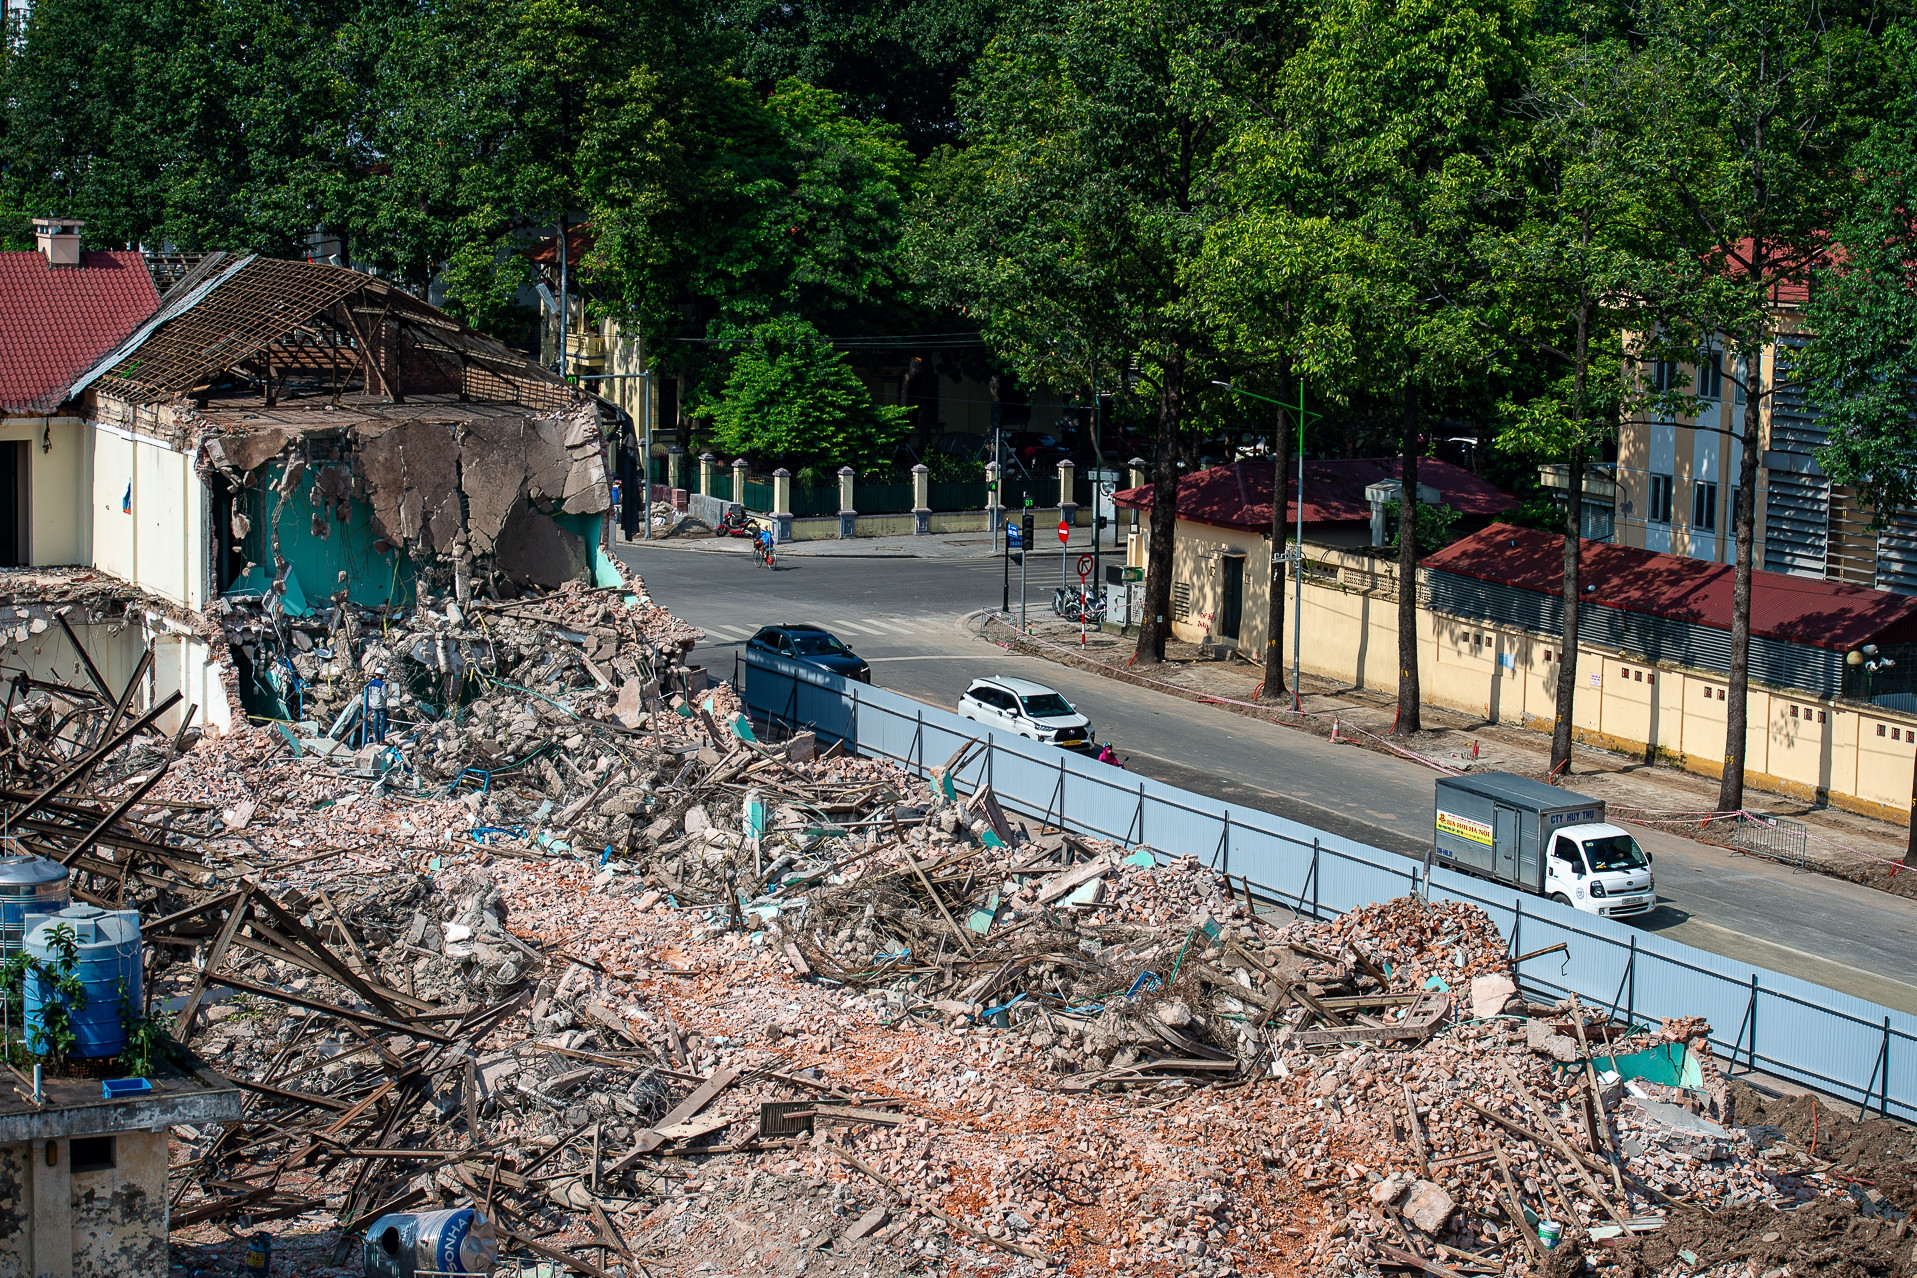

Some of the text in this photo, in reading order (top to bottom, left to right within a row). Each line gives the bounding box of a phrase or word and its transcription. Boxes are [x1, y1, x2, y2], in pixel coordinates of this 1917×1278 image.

[1550, 809, 1595, 824] CTY HUY THỤ
[445, 1218, 468, 1273] SONHA
